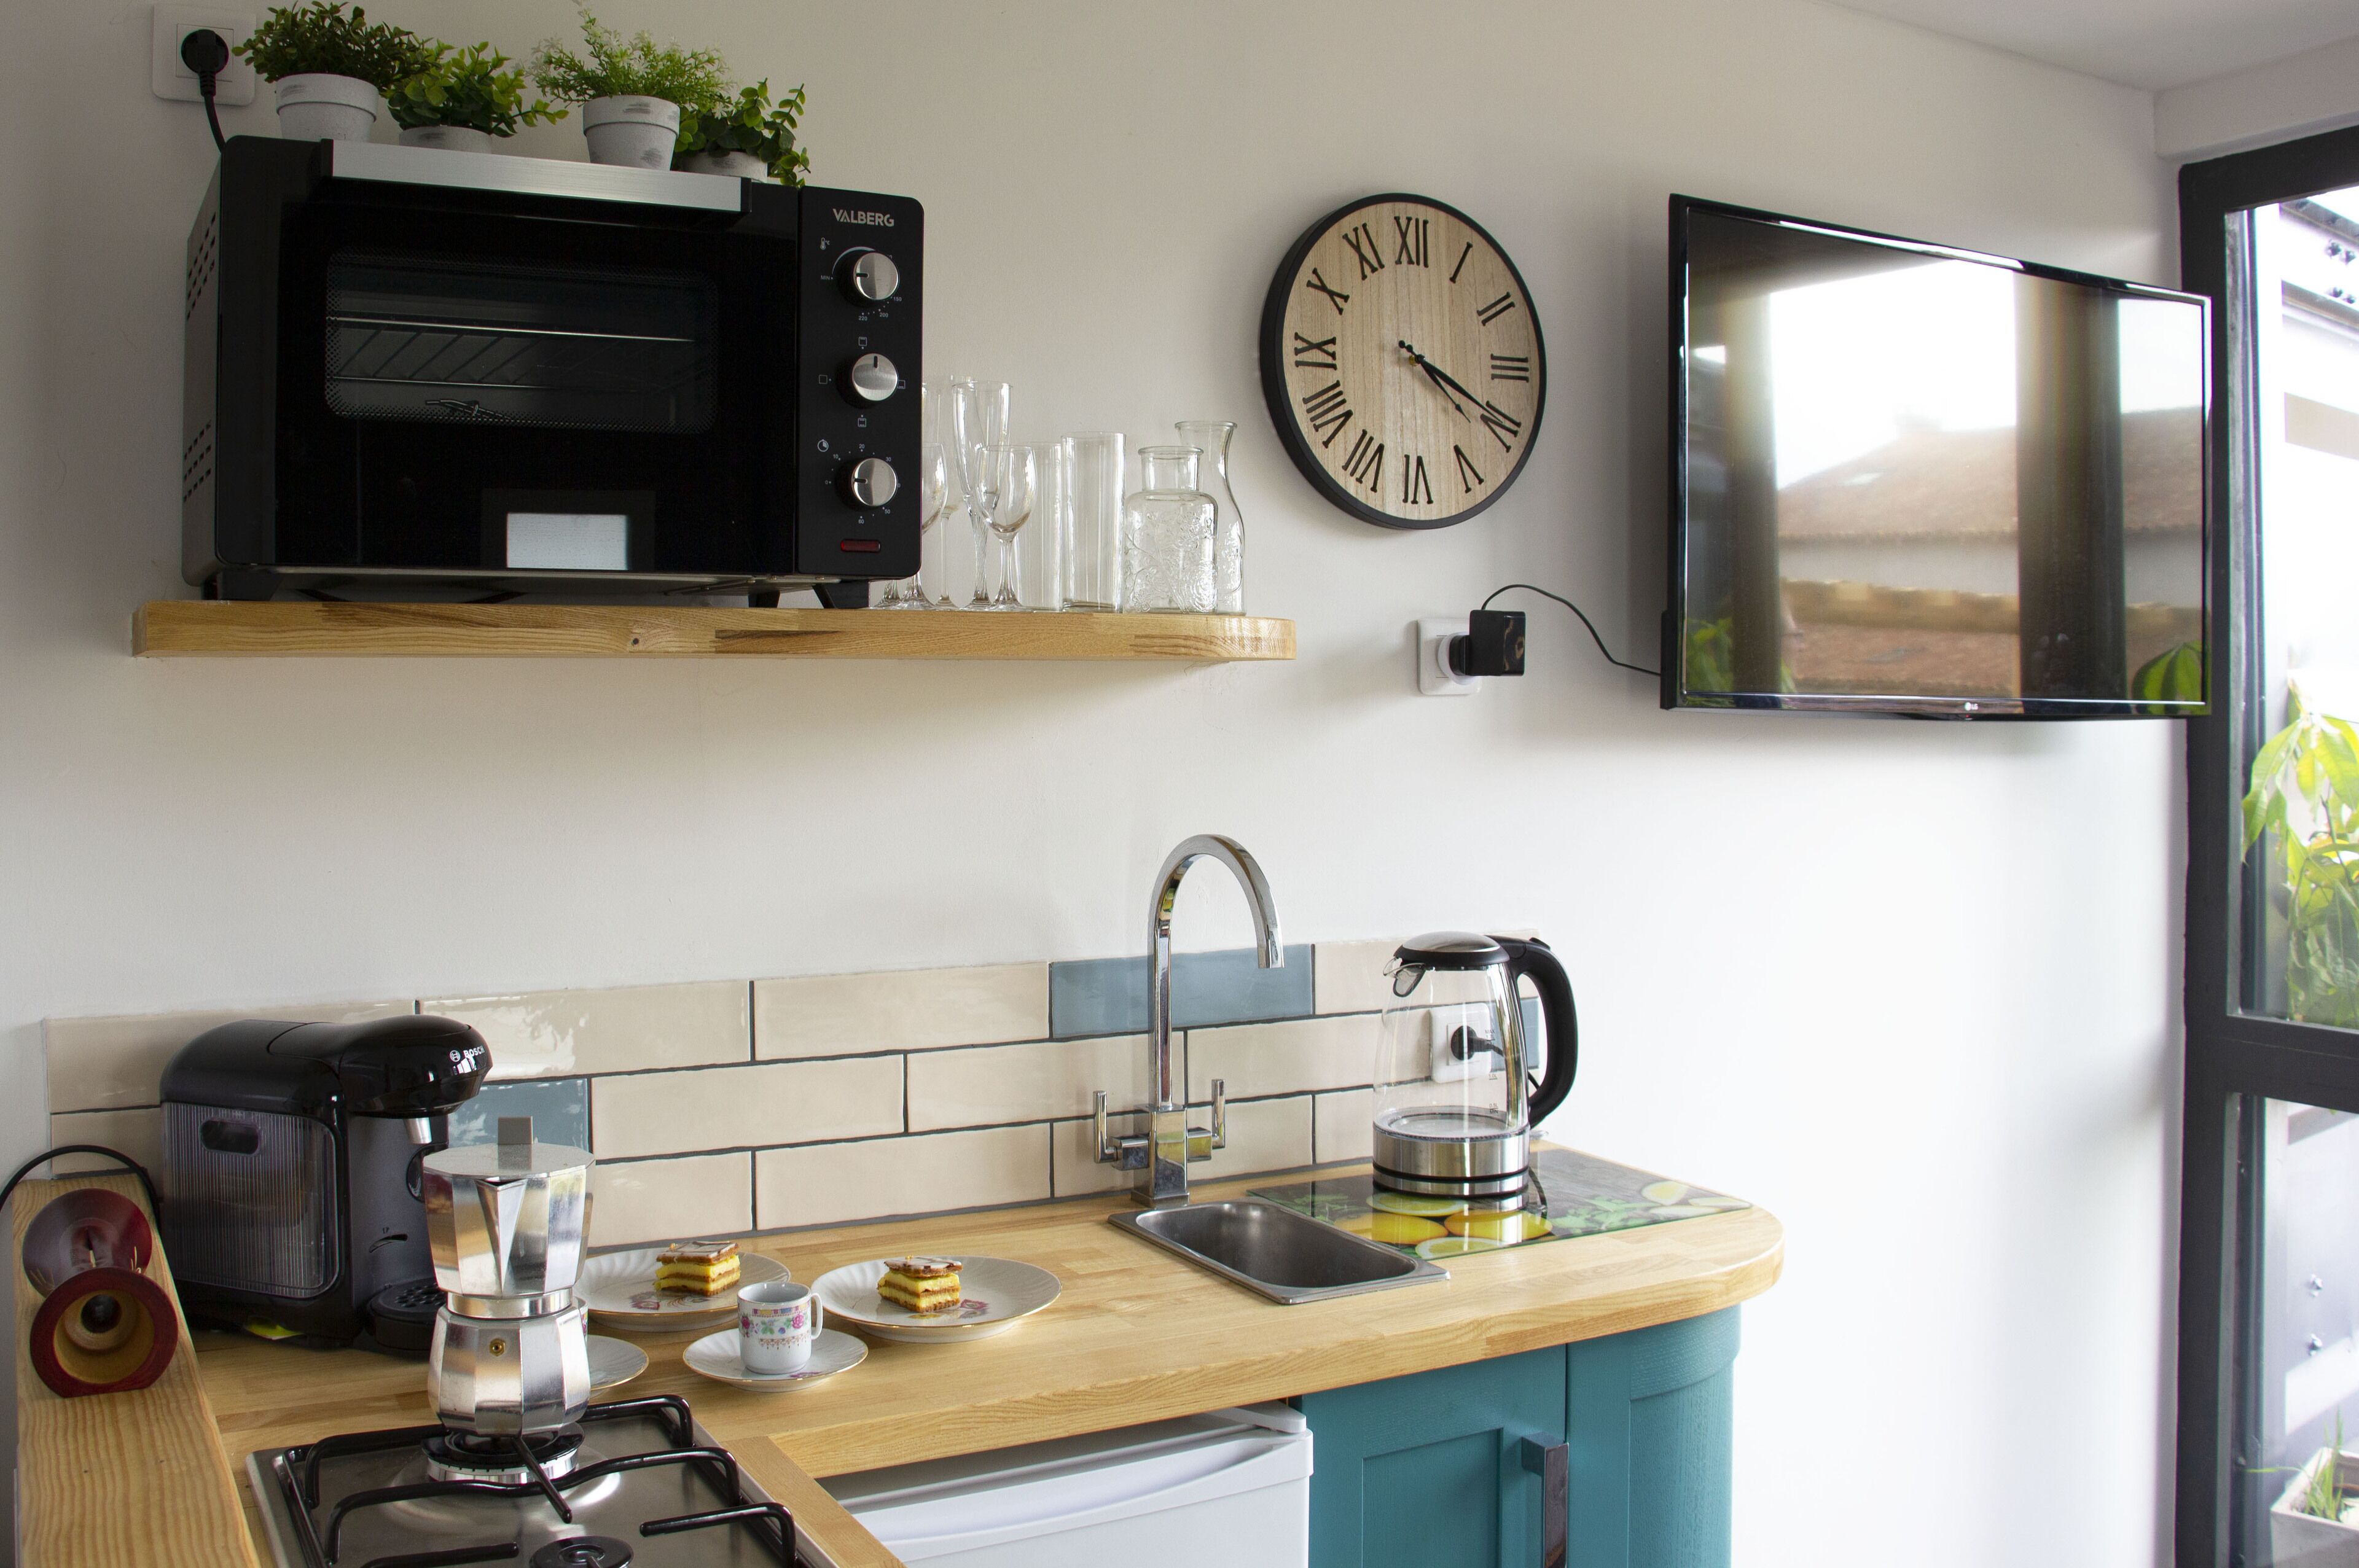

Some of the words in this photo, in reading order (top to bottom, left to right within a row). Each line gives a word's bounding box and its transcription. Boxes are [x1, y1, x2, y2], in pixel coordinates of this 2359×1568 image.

[833, 208, 894, 227] VALBERG
[1342, 222, 1385, 280] XI
[1394, 216, 1429, 268] XII
[1450, 241, 1473, 283] I
[1307, 268, 1350, 315] X
[1477, 292, 1516, 326] II
[1294, 332, 1337, 370] IX
[1490, 353, 1530, 383] III
[1303, 380, 1353, 448] VIII
[1481, 400, 1522, 453] IV
[1342, 429, 1385, 493] VII
[1403, 454, 1434, 504] VI
[1453, 444, 1484, 493] V
[463, 1045, 485, 1059] BOSCH
